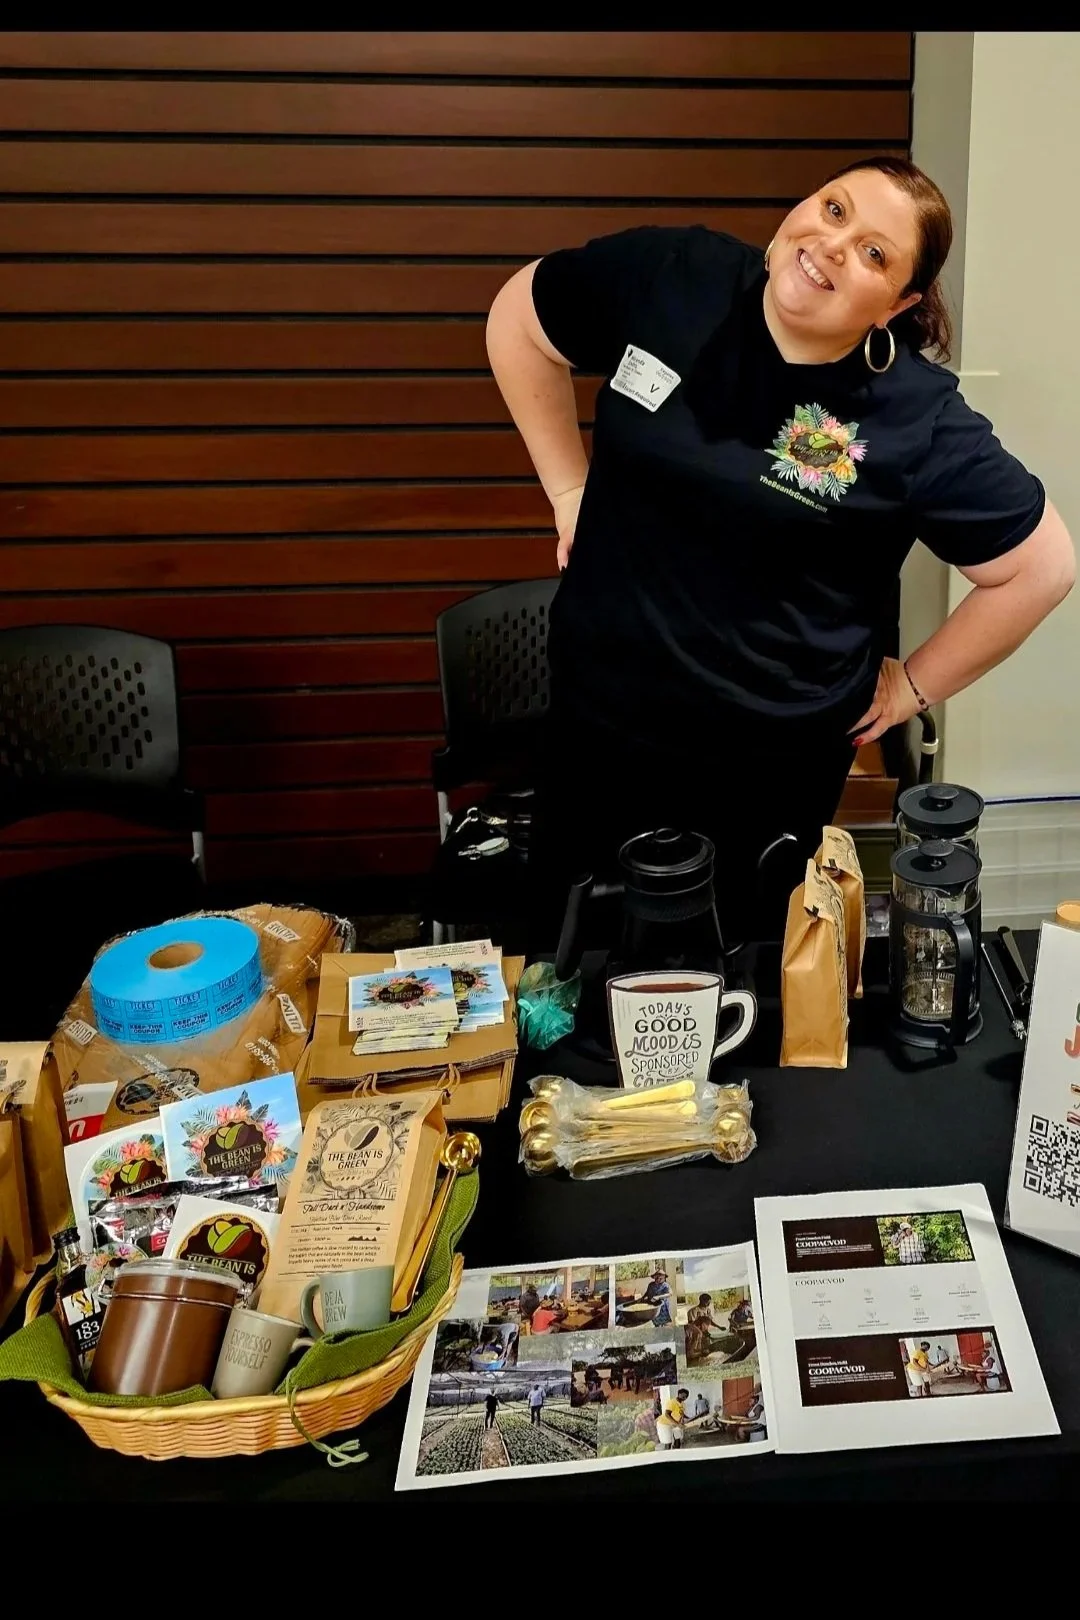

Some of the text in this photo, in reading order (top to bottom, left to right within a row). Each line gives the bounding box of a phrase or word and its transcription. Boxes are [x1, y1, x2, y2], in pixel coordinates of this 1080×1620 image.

[650, 383, 660, 393] V
[759, 475, 828, 513] TheBeanIsGreen.com
[281, 995, 301, 1030] ULINE
[639, 1001, 692, 1018] TODAY'S
[69, 1021, 92, 1044] ULINE
[634, 1017, 697, 1034] GOOD
[627, 1035, 678, 1055] MOOD
[631, 1051, 699, 1074] SPONSORED
[208, 1144, 262, 1166] THE BEAN IS
[221, 1155, 251, 1170] GREEN
[328, 1150, 384, 1162] THE BEAN IS
[338, 1160, 368, 1170] GREEN
[320, 1202, 338, 1212] Dark
[348, 1201, 386, 1212] Handsome
[796, 1238, 847, 1249] COOPACVOD
[211, 1258, 242, 1273] BEAN
[244, 1263, 257, 1275] IS
[795, 1277, 846, 1287] COOPACVOD
[324, 1288, 344, 1307] DEJA
[325, 1304, 347, 1324] BREW
[230, 1328, 272, 1354] ESPRESSO
[224, 1344, 268, 1370] YOURSELF
[808, 1364, 866, 1377] COOPACVOD
